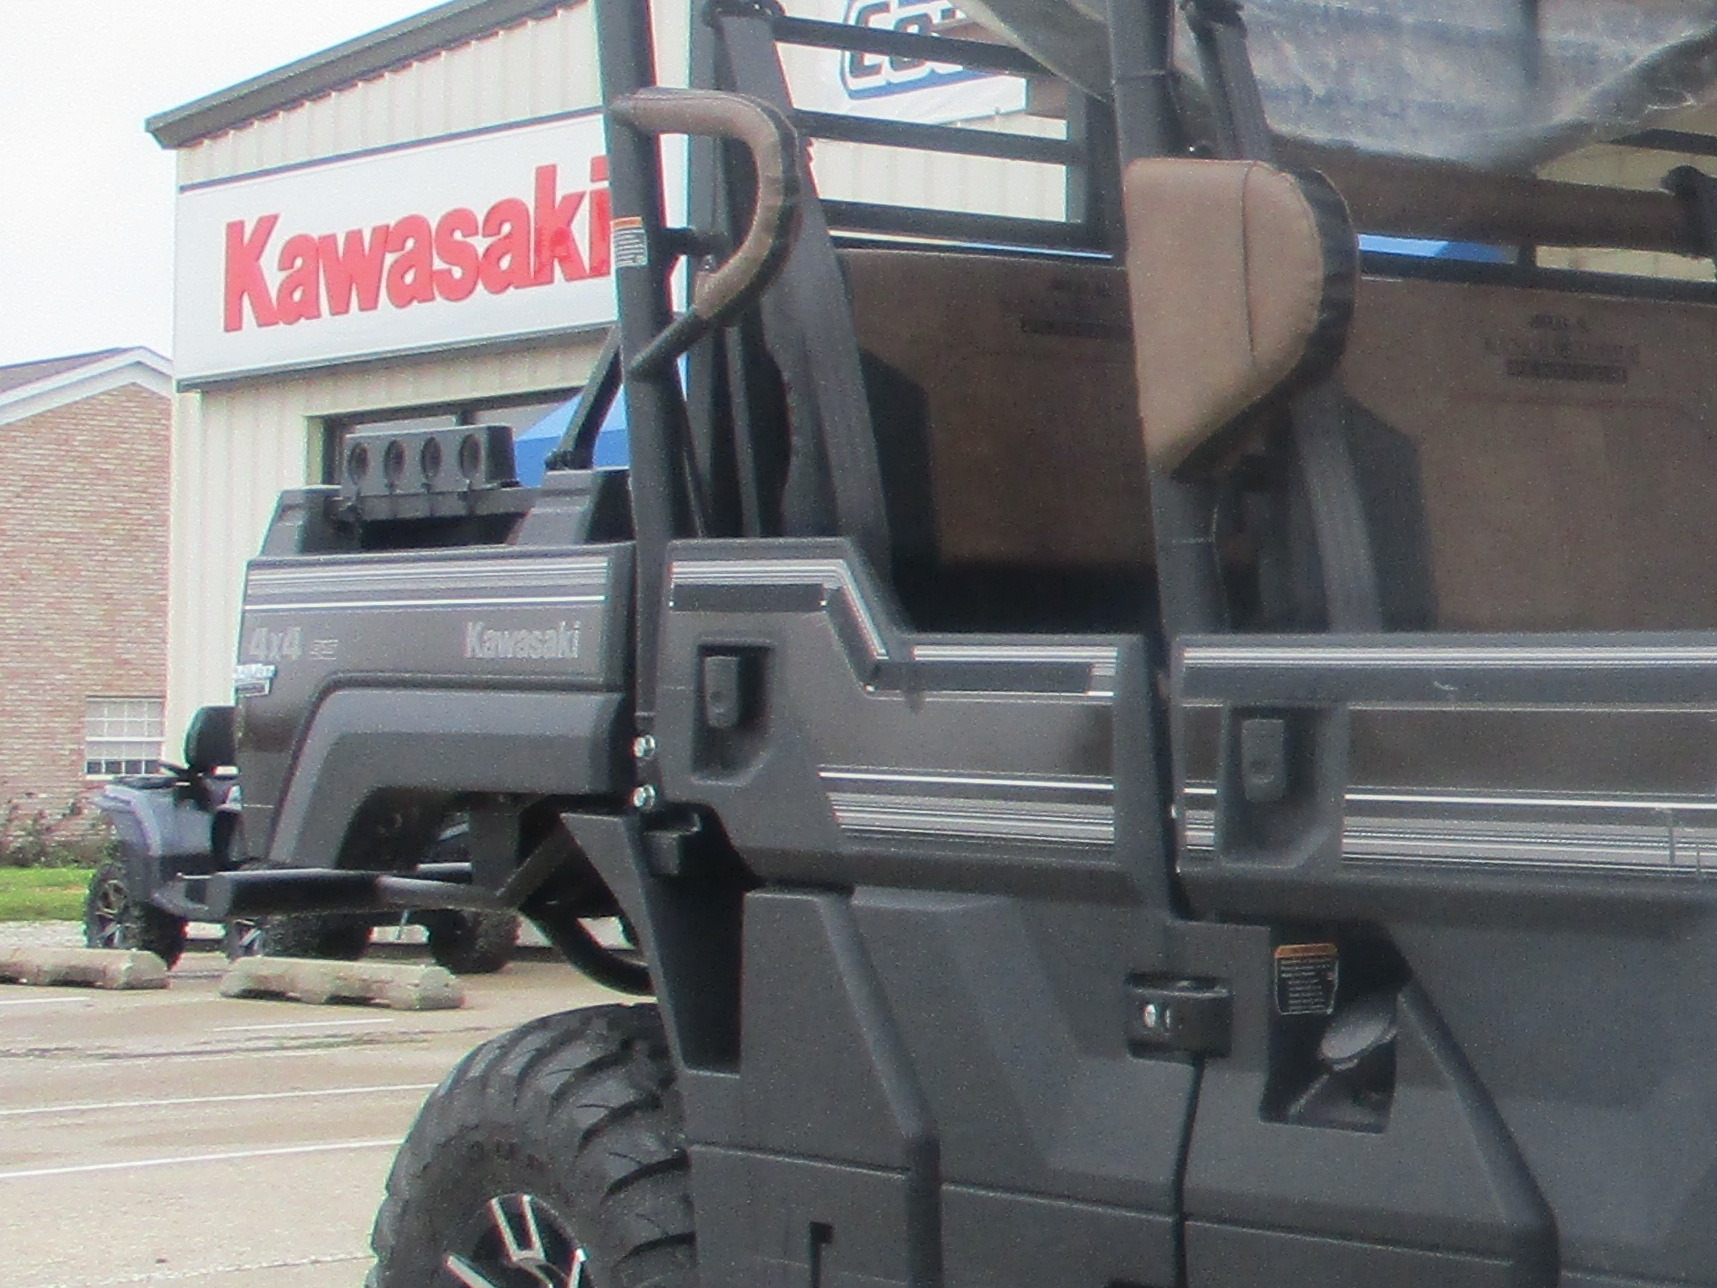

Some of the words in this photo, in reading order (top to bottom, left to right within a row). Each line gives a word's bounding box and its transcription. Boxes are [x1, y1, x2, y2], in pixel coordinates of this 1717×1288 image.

[223, 155, 611, 333] Kawasaki
[249, 626, 302, 662] 4x4
[464, 620, 581, 660] Kawasaki
